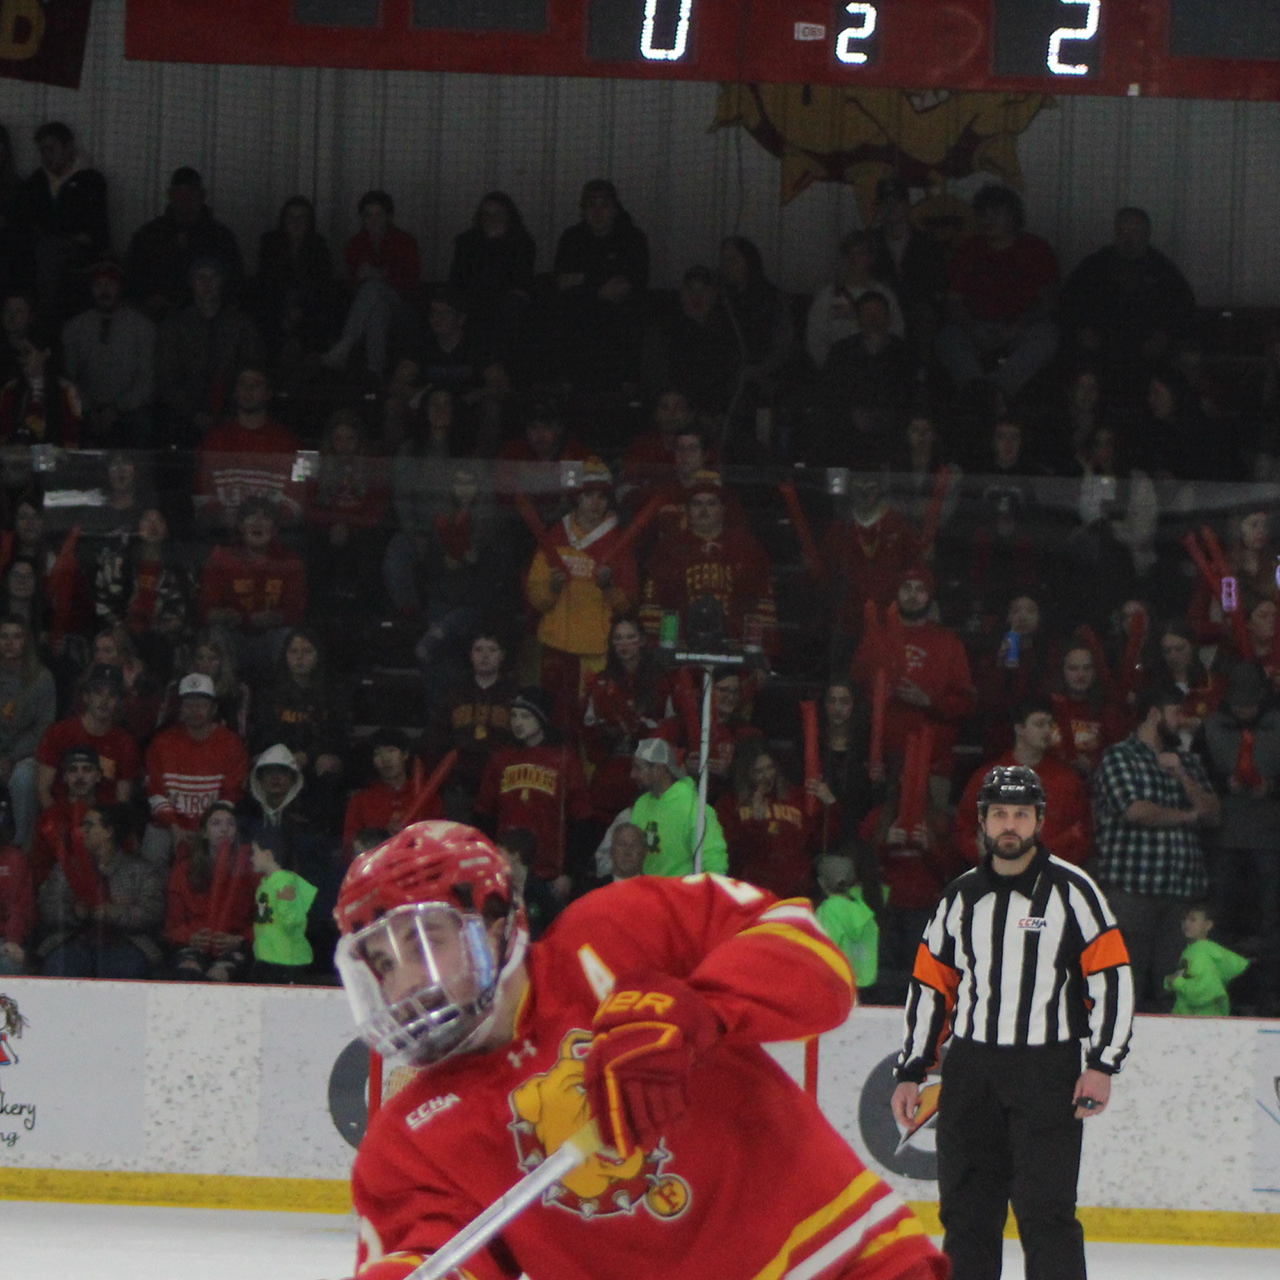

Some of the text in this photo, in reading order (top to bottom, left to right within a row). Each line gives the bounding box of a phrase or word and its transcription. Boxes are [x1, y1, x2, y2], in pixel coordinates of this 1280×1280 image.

[835, 2, 877, 64] 2
[1047, 0, 1102, 75] 2
[1018, 918, 1047, 929] CCHA
[406, 1092, 462, 1131] CCHA
